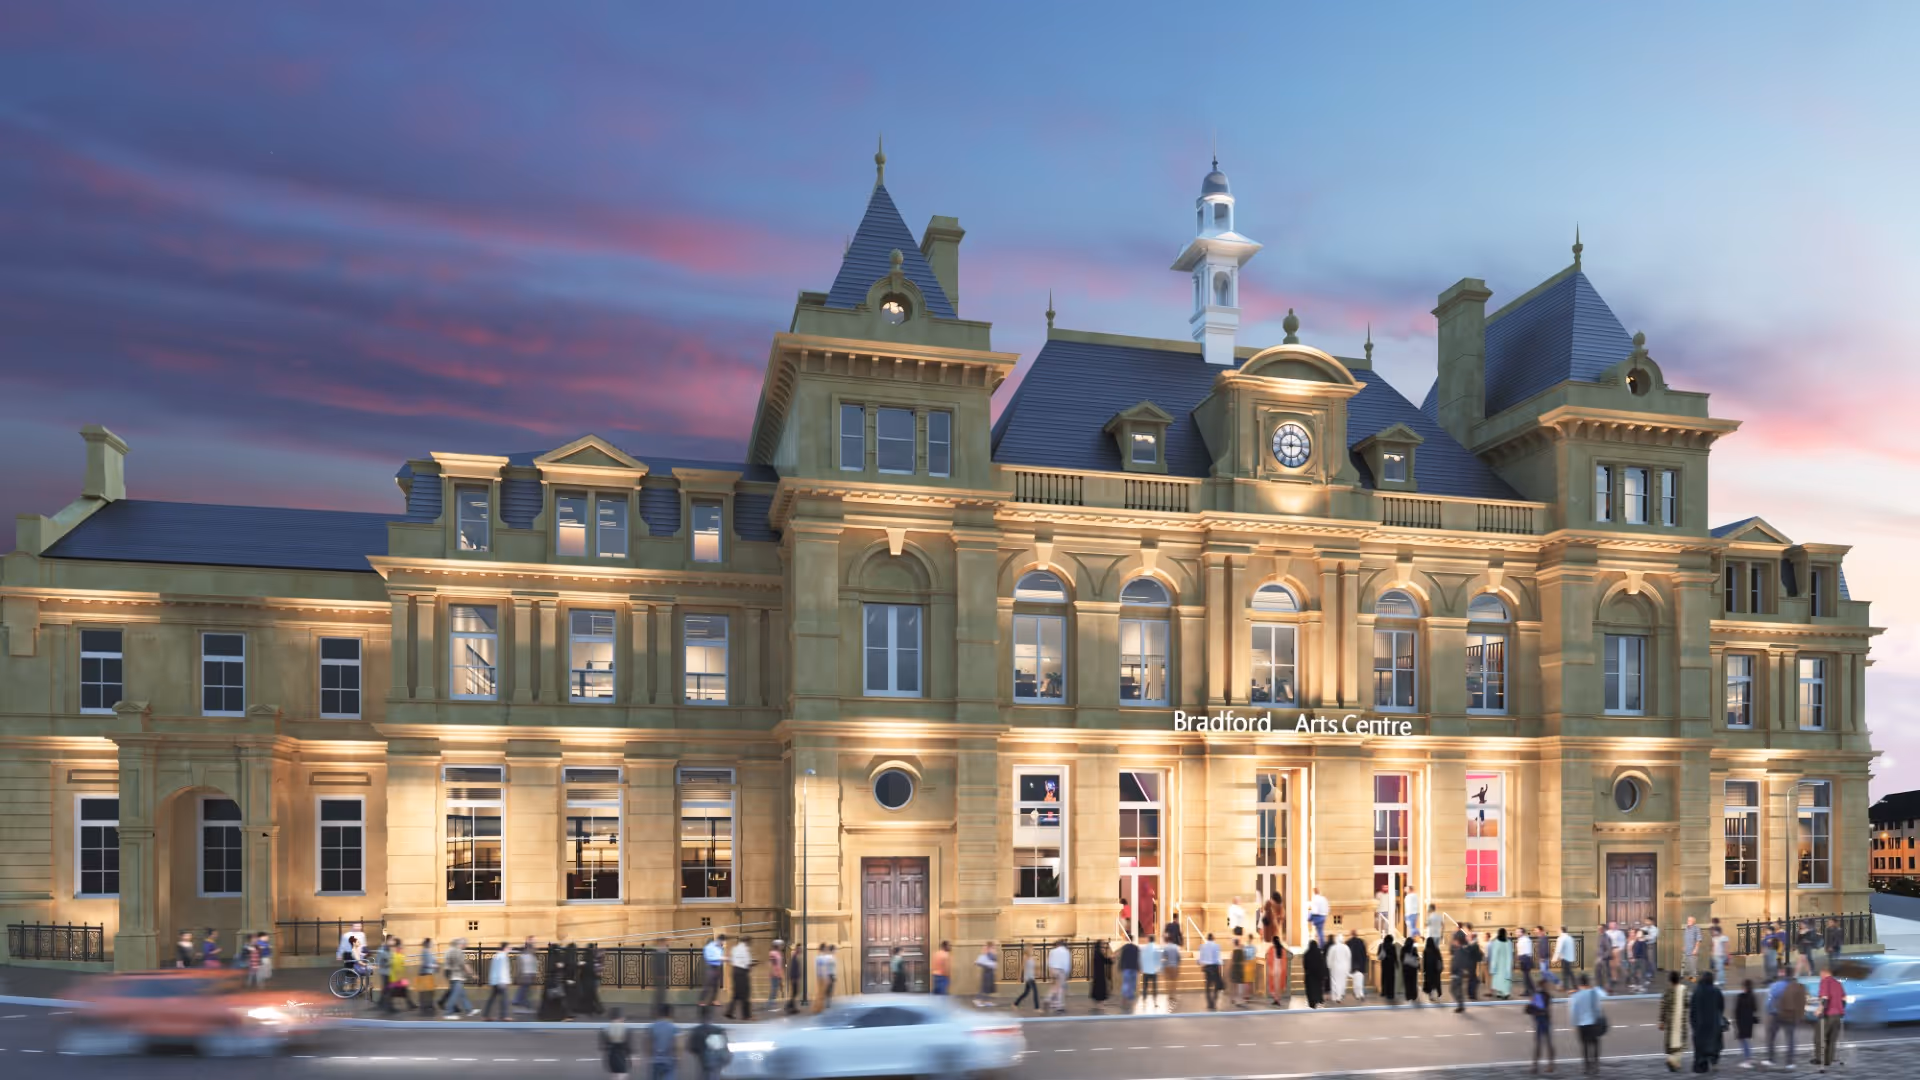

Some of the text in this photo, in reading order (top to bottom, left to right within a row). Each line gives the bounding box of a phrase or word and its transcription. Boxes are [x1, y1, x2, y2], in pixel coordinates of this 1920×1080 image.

[1174, 710, 1412, 736] Bradford Arts Centre
